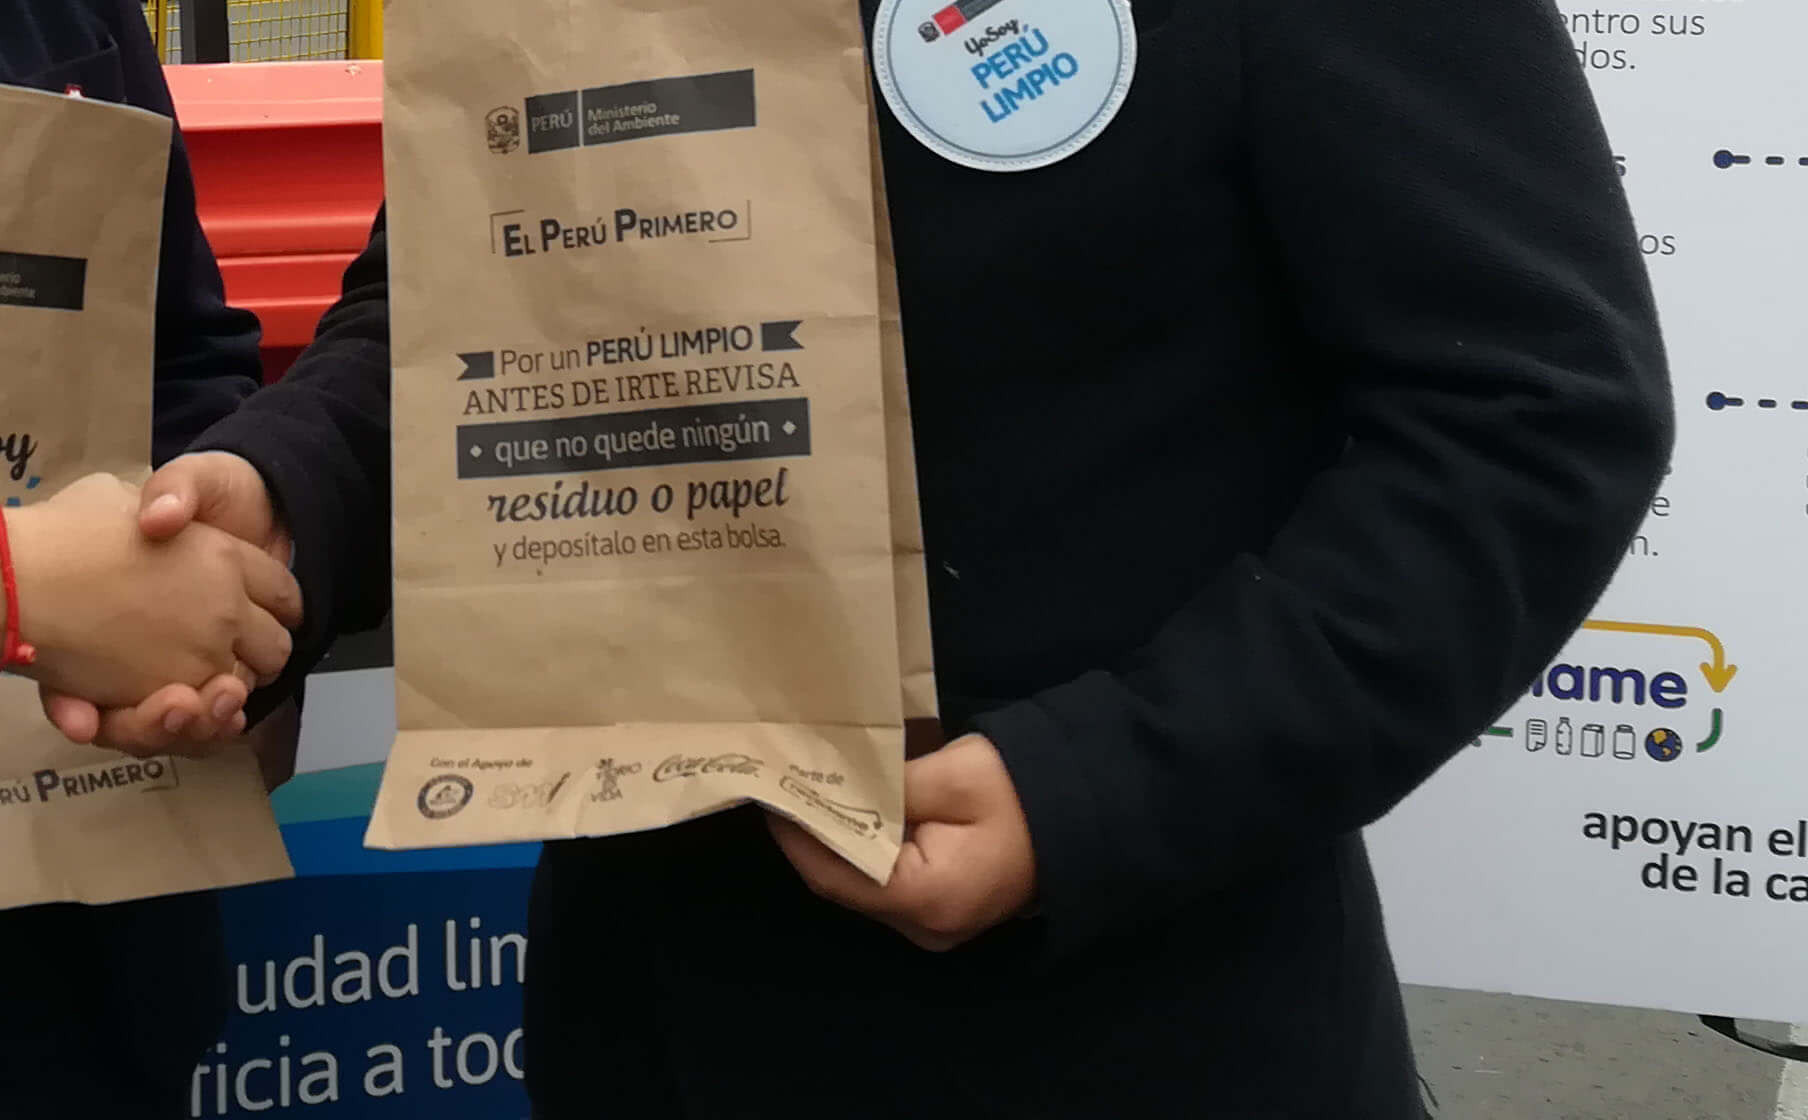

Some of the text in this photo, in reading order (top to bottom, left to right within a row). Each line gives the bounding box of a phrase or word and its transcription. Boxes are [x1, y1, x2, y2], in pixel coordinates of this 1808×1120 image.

[1651, 14, 1705, 35] sus
[970, 24, 1049, 89] PERÚ
[588, 101, 657, 122] Ministerio
[980, 52, 1079, 124] LIMPIO
[531, 110, 573, 132] PERÚ
[588, 113, 680, 137] del Ambiente
[500, 325, 752, 375] Por un PERÚ LIMPIO
[462, 362, 800, 415] ANTES DE IRTE REVISA
[495, 413, 770, 468] que no quede ningún
[488, 467, 790, 523] residuo o papel
[494, 541, 507, 567] y
[642, 535, 670, 552] en
[678, 528, 722, 549] esta
[727, 524, 787, 549] bolsa.
[1582, 811, 1808, 858] apoyan el
[1641, 852, 1698, 892] de
[1713, 857, 1750, 897] la
[363, 1044, 404, 1097] a
